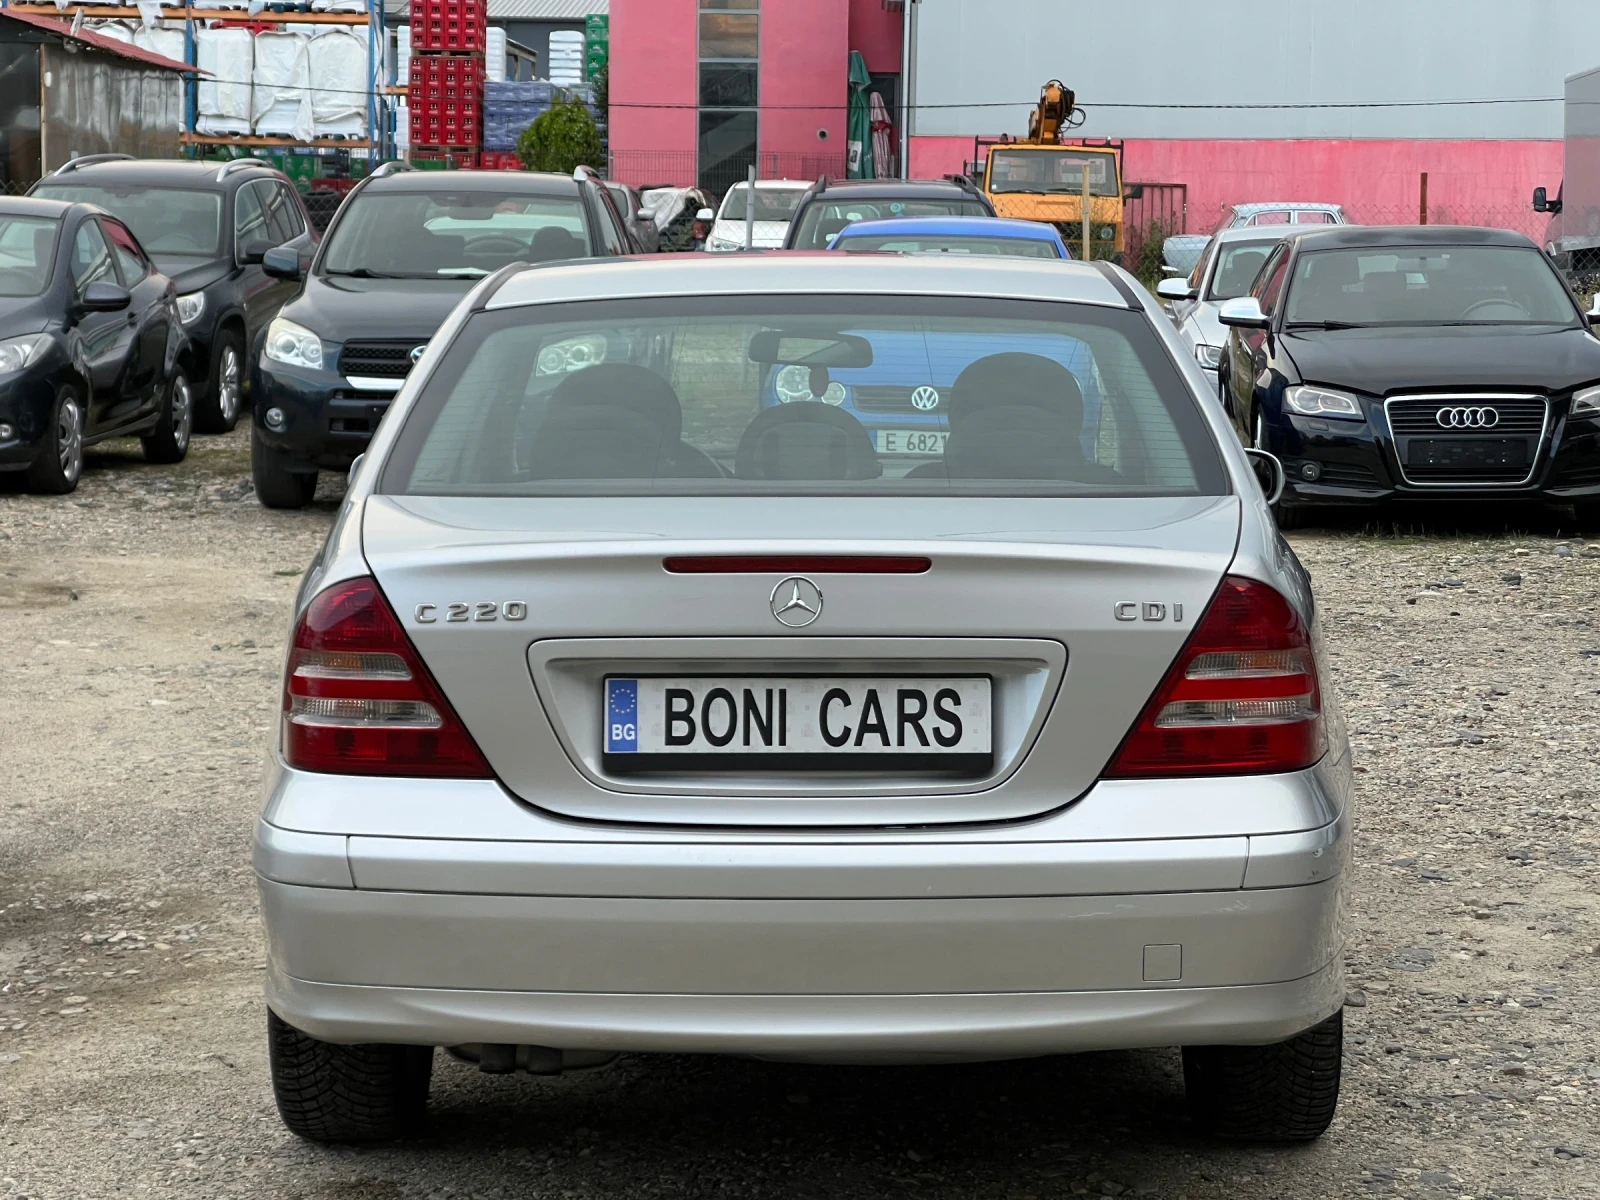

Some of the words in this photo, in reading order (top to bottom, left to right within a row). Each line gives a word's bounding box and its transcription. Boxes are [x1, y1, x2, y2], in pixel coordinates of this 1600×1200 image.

[885, 432, 897, 452] E
[414, 602, 437, 624] C
[446, 600, 528, 623] 220
[1113, 600, 1183, 622] CDI
[664, 687, 787, 747] BONI
[818, 687, 963, 747] CARS
[611, 723, 636, 741] BG
